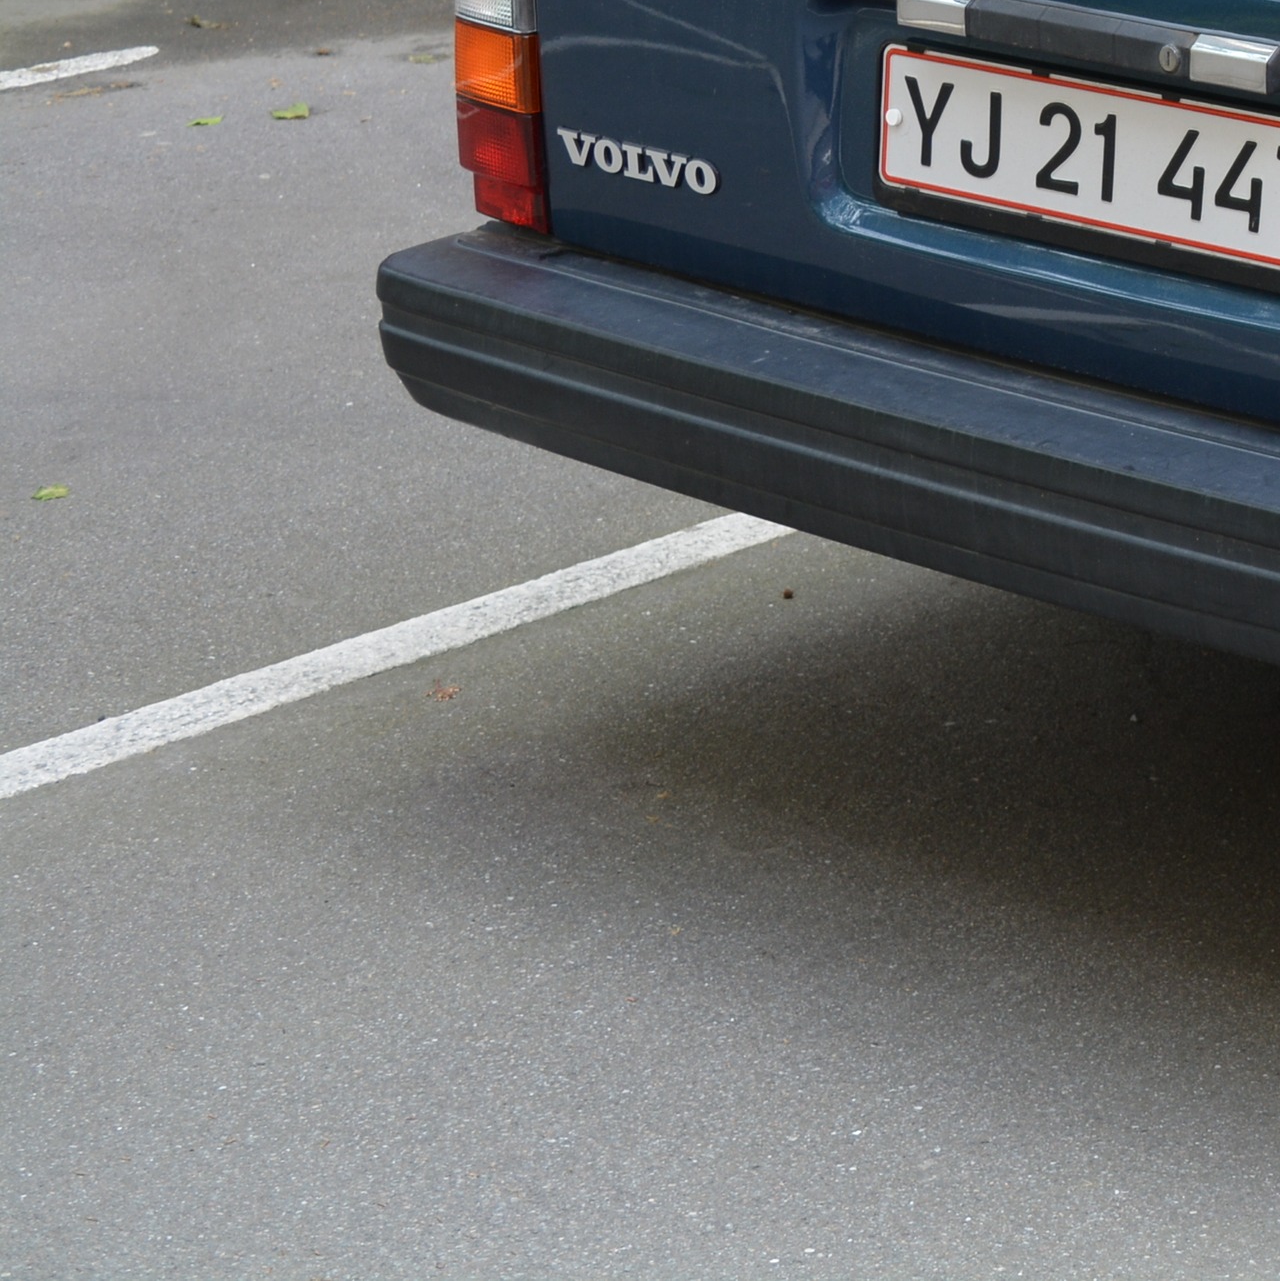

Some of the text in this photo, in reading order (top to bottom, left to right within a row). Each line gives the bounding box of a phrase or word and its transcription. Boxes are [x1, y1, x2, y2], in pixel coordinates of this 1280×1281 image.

[556, 125, 719, 196] VOLVO
[904, 75, 1003, 179] YJ
[1035, 101, 1118, 203] 21
